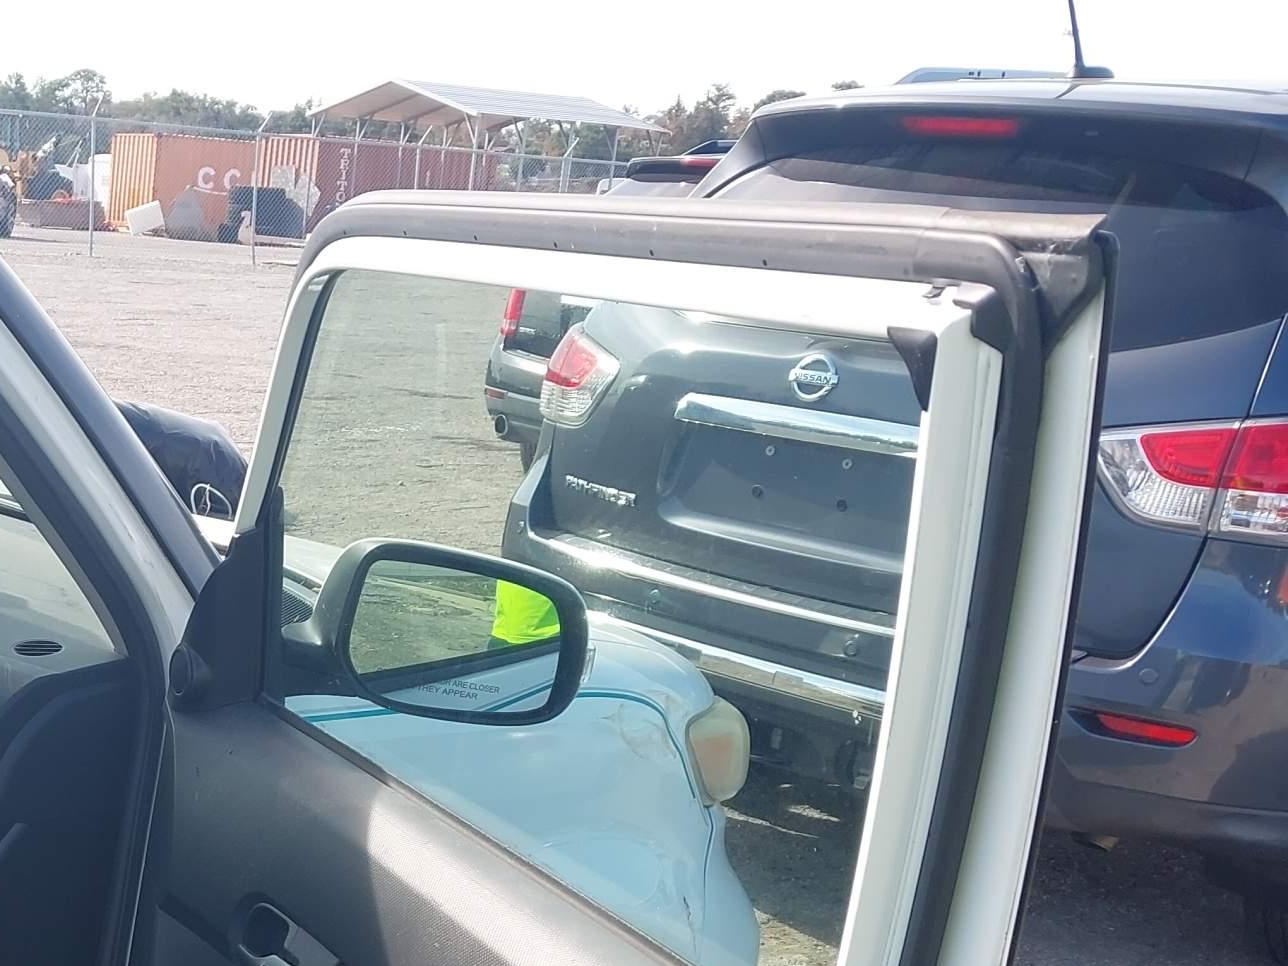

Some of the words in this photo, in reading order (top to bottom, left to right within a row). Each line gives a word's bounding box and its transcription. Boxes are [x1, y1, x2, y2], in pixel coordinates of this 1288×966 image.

[335, 147, 352, 206] TRITO
[442, 687, 479, 700] APPEAR
[469, 682, 501, 694] CLOSER
